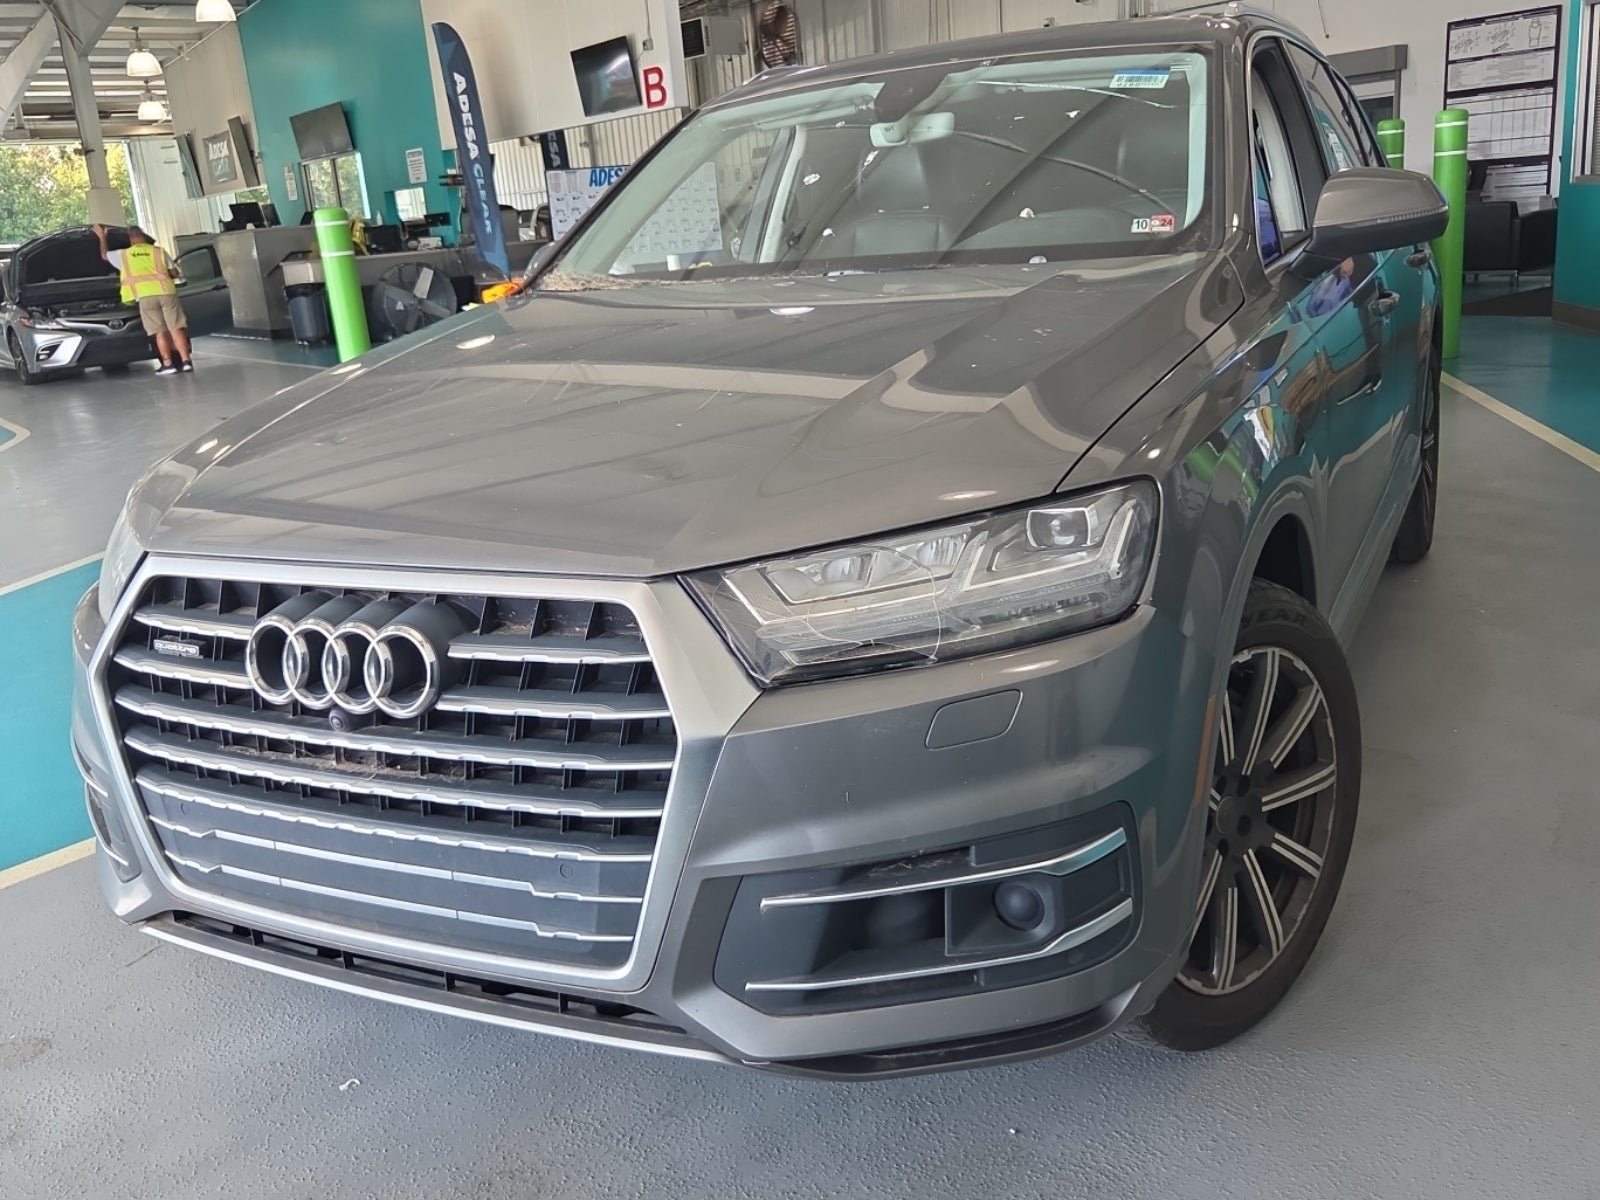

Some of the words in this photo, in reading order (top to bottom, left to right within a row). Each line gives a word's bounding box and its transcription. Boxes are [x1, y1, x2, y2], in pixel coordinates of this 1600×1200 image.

[643, 66, 667, 109] B
[453, 72, 479, 160] ADESA
[1135, 219, 1148, 230] 10
[1160, 218, 1172, 226] 24
[155, 641, 197, 655] quattro
